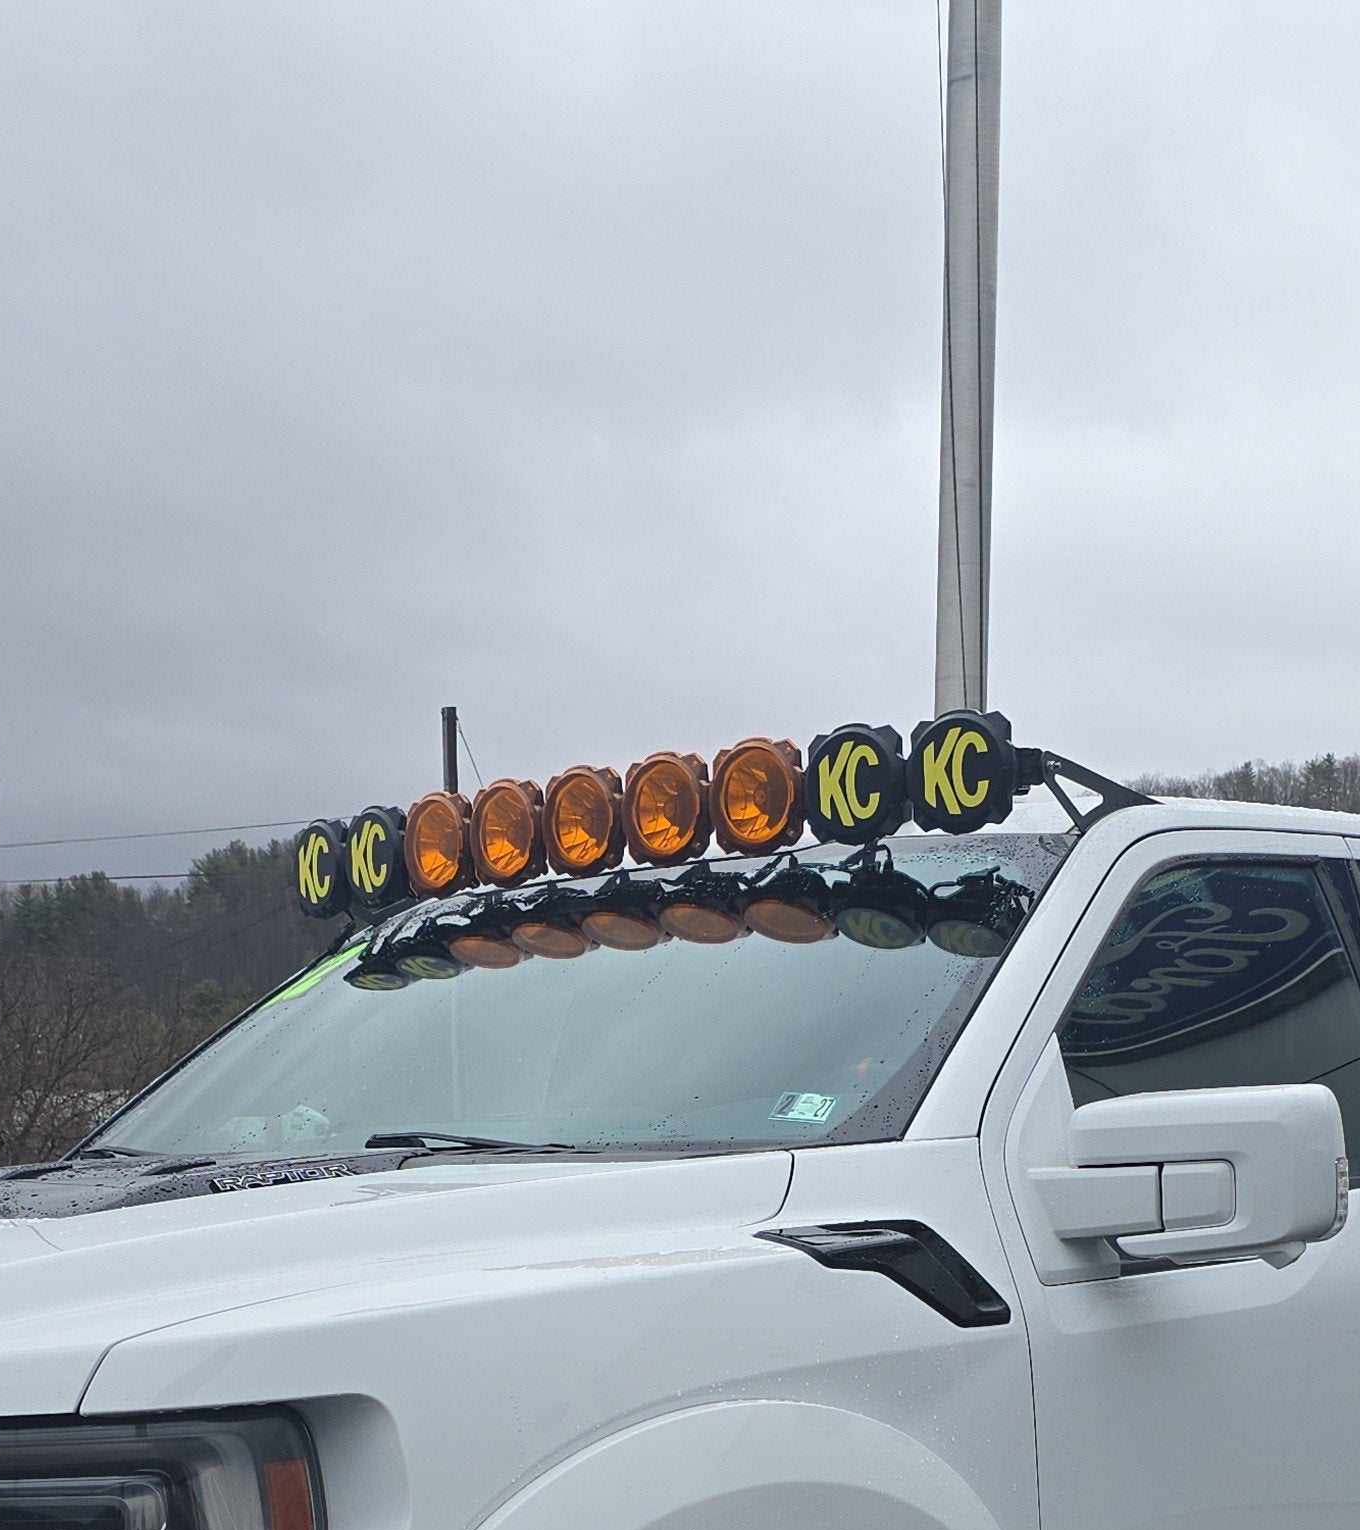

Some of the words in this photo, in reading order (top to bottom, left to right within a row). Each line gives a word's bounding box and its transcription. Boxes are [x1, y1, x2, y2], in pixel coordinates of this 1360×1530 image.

[818, 740, 881, 827] KC
[923, 726, 990, 816] KC
[298, 833, 331, 905] KC
[350, 820, 388, 894] KC
[213, 1164, 354, 1191] RAPTOR
